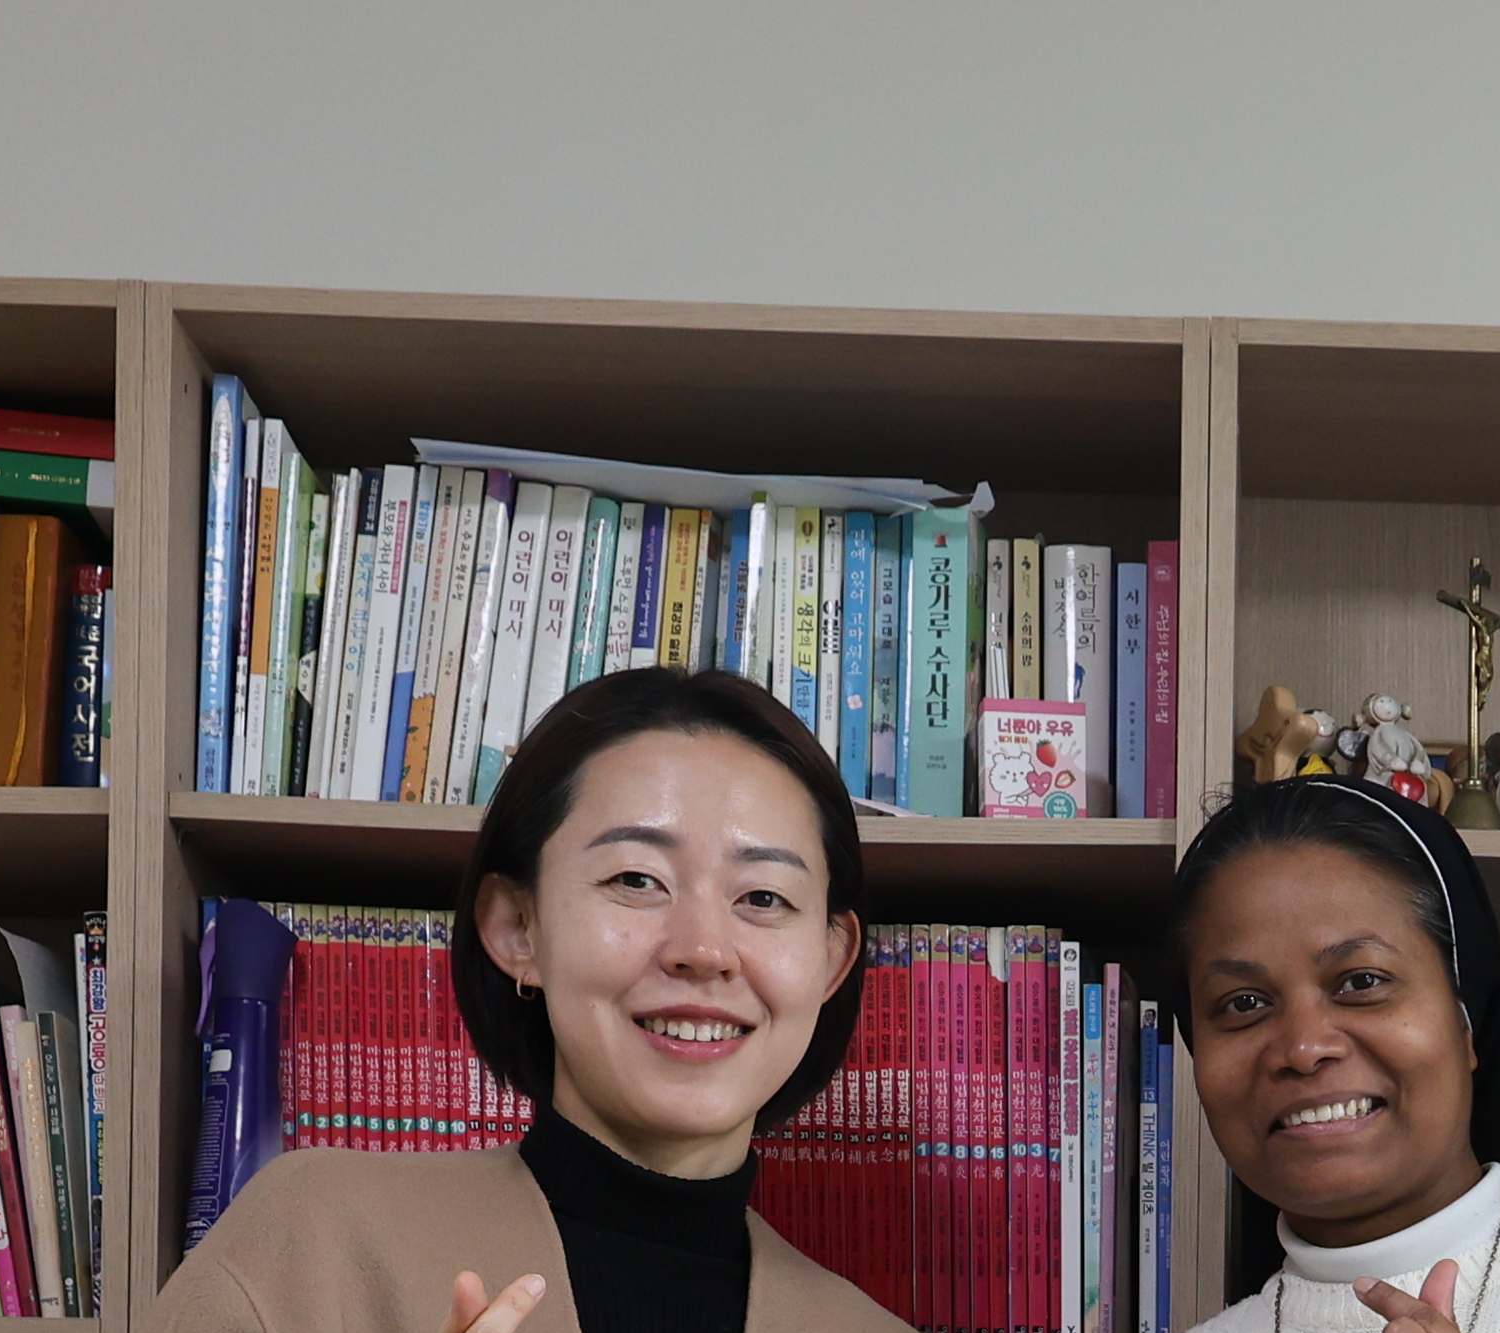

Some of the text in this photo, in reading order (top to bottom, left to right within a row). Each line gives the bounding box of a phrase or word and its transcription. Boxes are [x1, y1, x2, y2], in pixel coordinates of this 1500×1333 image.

[375, 500, 397, 595] 부모와 자녀 사이
[505, 599, 526, 639] 미사
[545, 598, 566, 639] 미사
[849, 570, 864, 605] 있어
[1076, 563, 1100, 654] 한여름의
[606, 619, 629, 657] 악플
[846, 612, 864, 676] 고마워요
[925, 557, 952, 729] 콩가루 수사단
[1125, 589, 1141, 655] 시한부
[796, 602, 814, 710] 생각의 크기만큼
[72, 646, 98, 762] 국어사전
[997, 718, 1074, 736] 너뿐야 우유
[298, 1041, 312, 1101] 마법천자문
[315, 1042, 329, 1104] 마법천자문
[332, 1041, 346, 1102] 마법천자문
[915, 1069, 930, 1135] 마법천자문
[934, 1069, 949, 1135] 마법천자문
[972, 1070, 987, 1137] 마법천자문
[1012, 1070, 1028, 1136] 마법천자문
[1029, 1069, 1045, 1136] 마법천자문
[954, 1071, 969, 1138] 마법천자문
[991, 1073, 1006, 1140] 마법천자문
[1143, 1113, 1155, 1157] THINK
[1142, 1178, 1154, 1216] 게이츠
